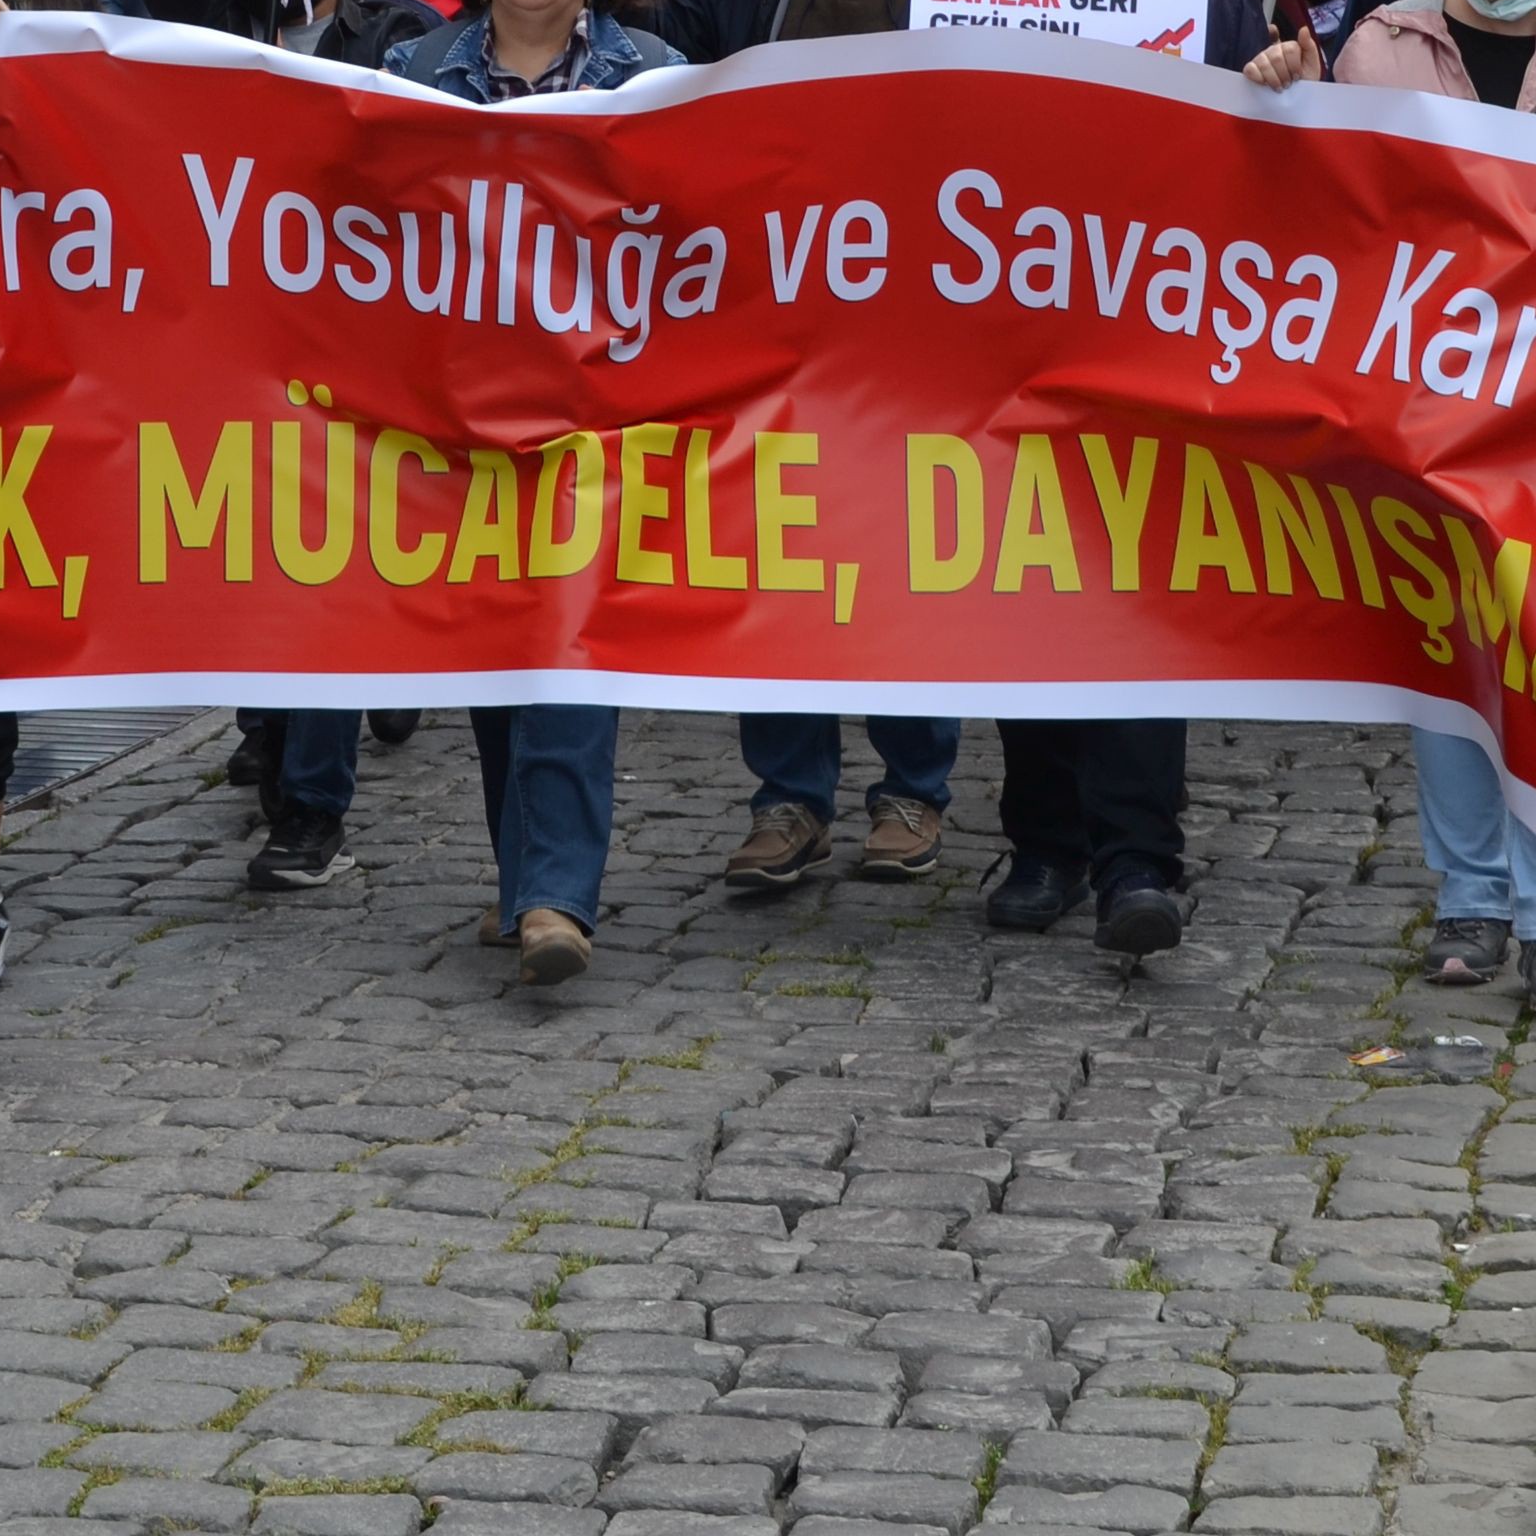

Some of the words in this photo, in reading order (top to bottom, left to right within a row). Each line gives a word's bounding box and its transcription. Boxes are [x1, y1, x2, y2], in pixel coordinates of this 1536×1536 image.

[181, 152, 728, 364] Yosulluğa
[763, 198, 889, 305] ve
[930, 167, 1340, 388] Savaşa
[136, 376, 861, 626] MÜCADELE,
